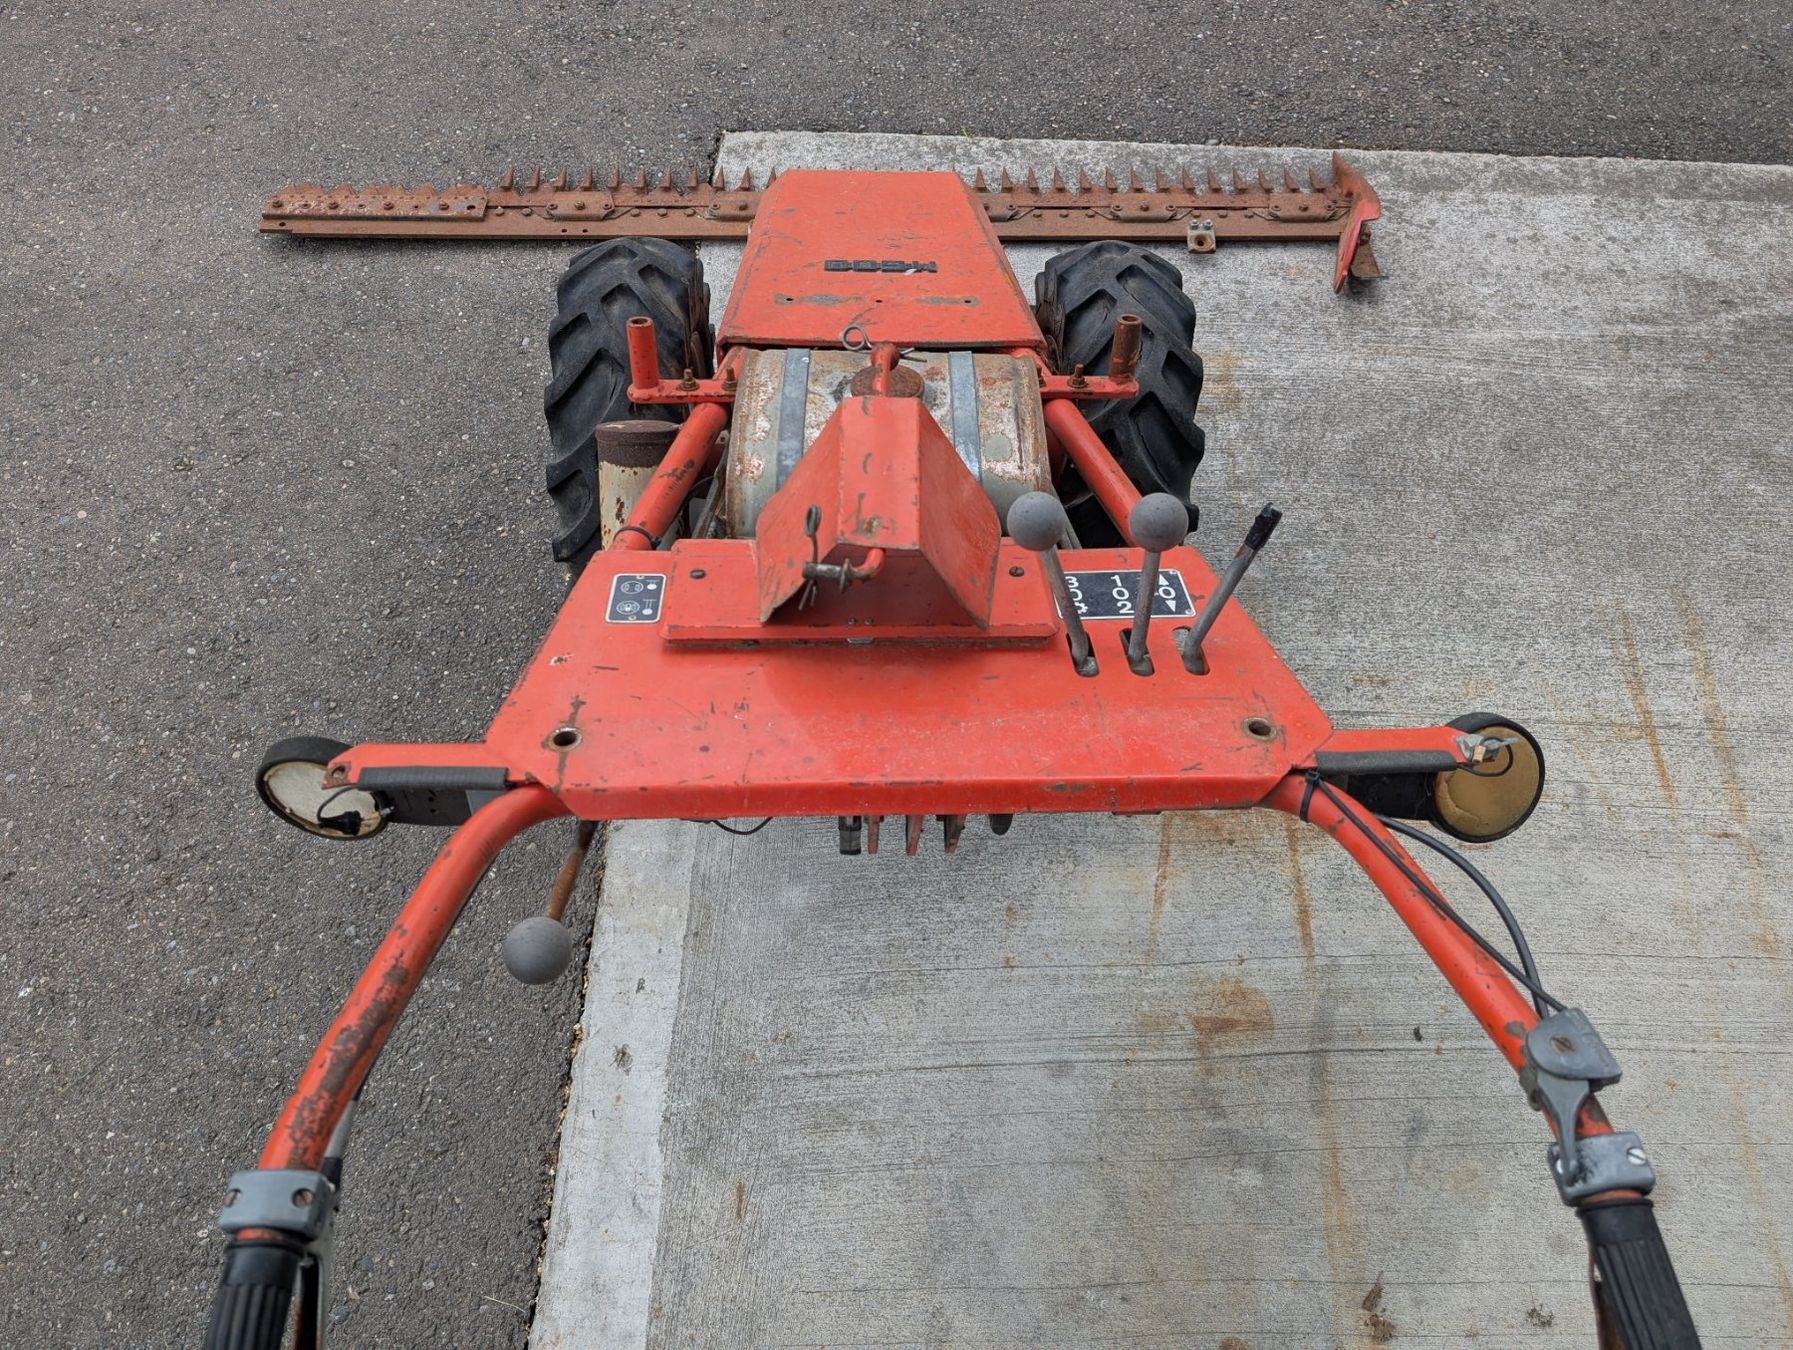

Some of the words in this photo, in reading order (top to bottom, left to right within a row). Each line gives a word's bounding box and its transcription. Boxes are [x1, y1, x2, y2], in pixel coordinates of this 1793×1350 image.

[1065, 576, 1079, 588] 3
[1110, 575, 1122, 587] 1
[1112, 588, 1129, 600] 0
[1116, 601, 1134, 613] 2
